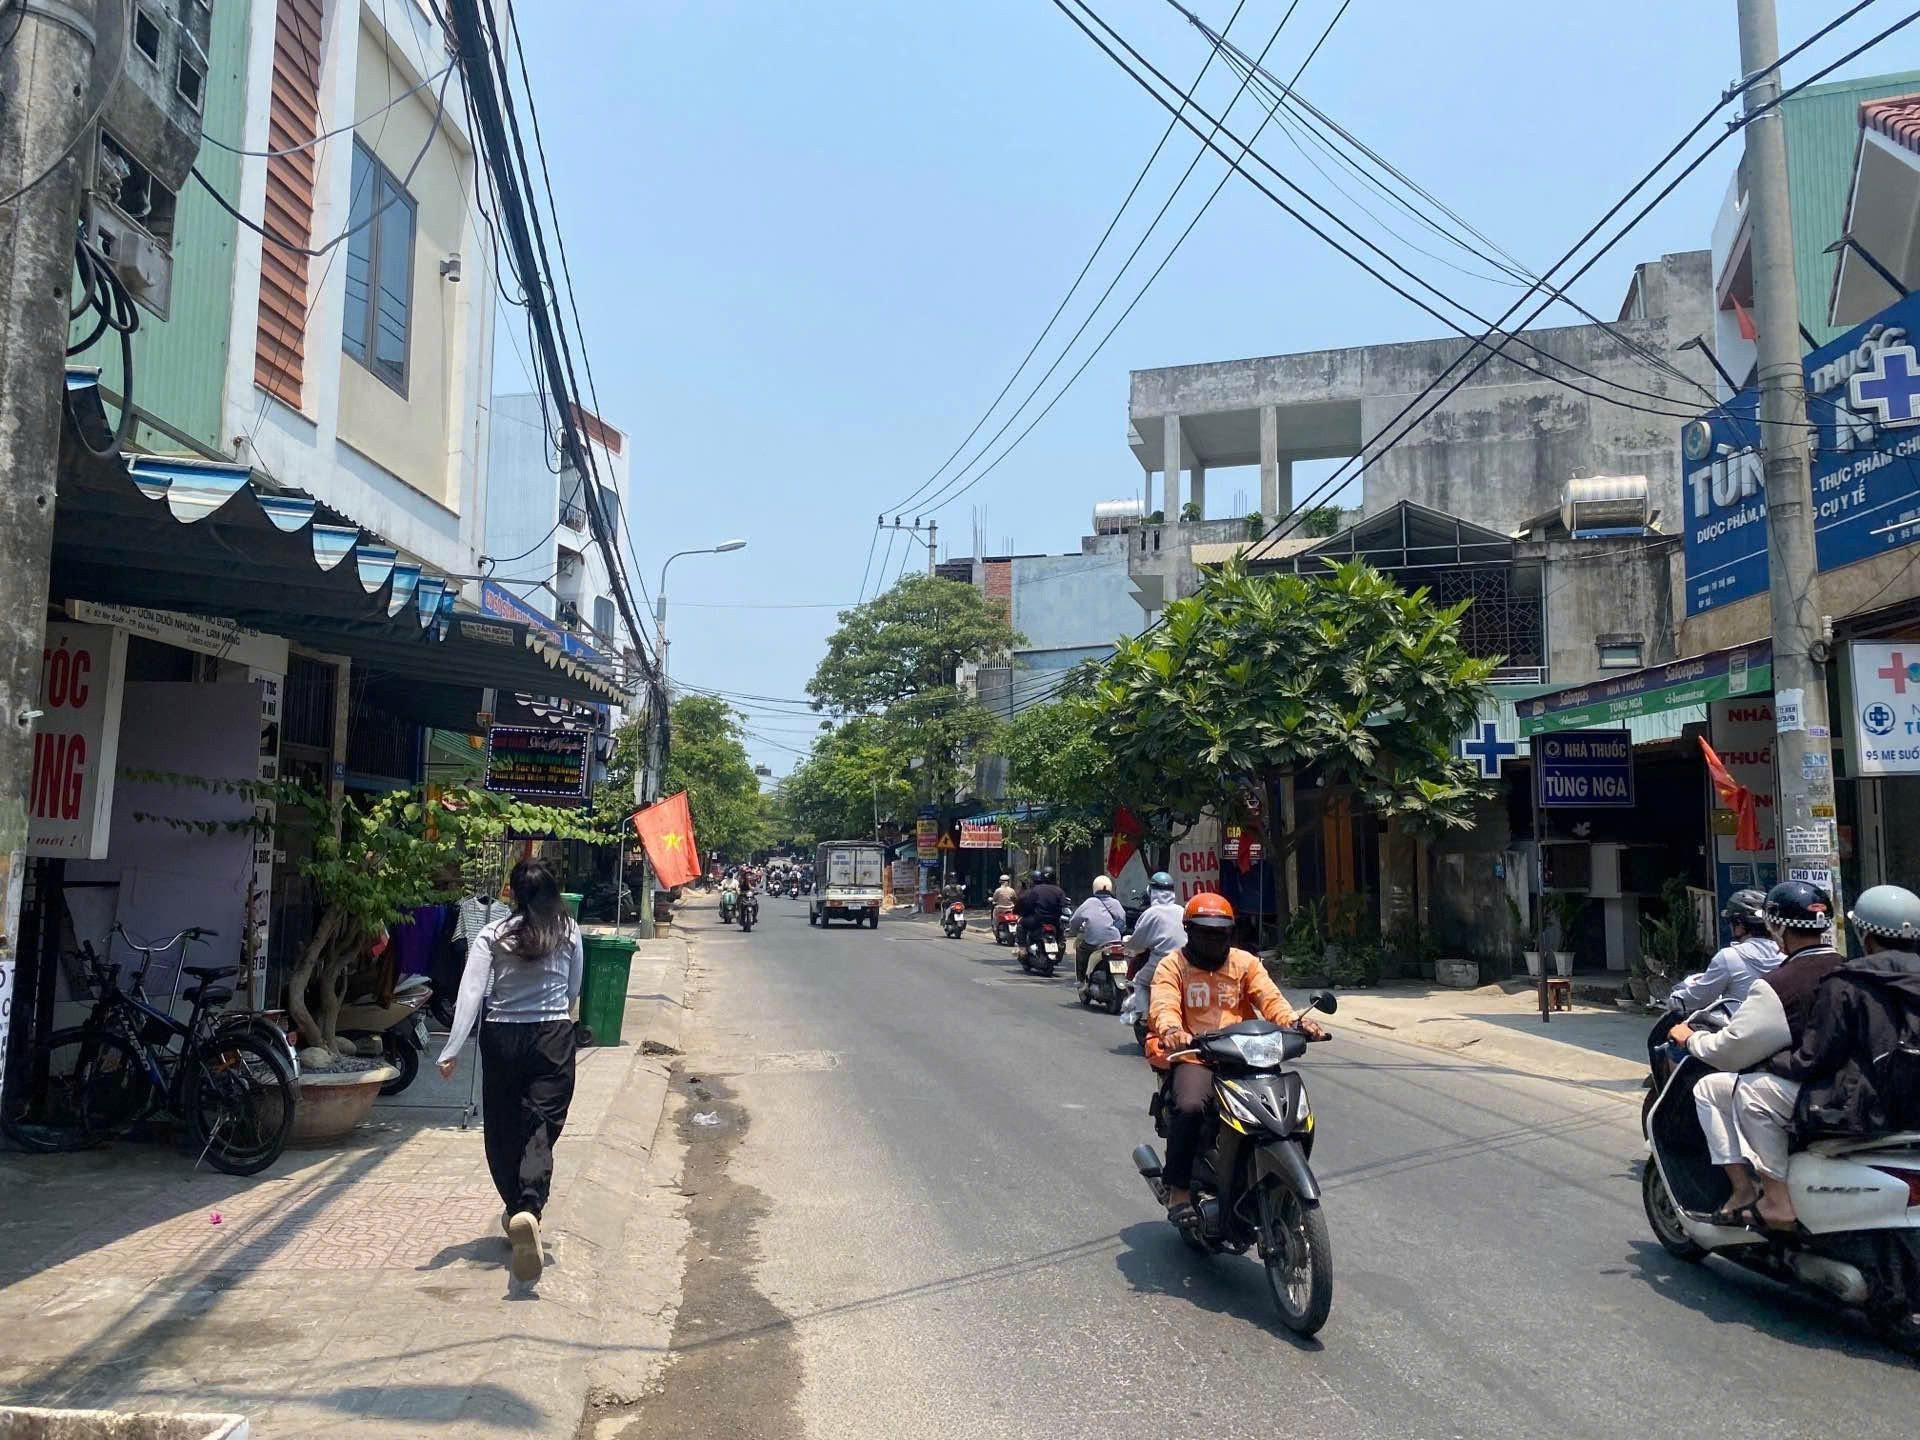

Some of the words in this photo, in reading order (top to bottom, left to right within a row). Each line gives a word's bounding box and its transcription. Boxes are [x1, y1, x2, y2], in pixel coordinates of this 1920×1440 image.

[1819, 467, 1852, 491] THỰC
[1820, 498, 1840, 518] CỤ
[1839, 495, 1851, 510] Y
[1851, 479, 1867, 504] TẾ
[1697, 520, 1726, 545] DƯỢC
[44, 637, 91, 709] ÓC
[1665, 661, 1705, 682] Salonpas
[1728, 704, 1774, 722] NHÀ
[1564, 741, 1588, 759] NHÀ
[1590, 737, 1627, 759] THUỐC
[1866, 750, 1879, 761] 95
[1881, 749, 1896, 763] MẸ
[1546, 770, 1589, 798] TÙNG
[1592, 776, 1628, 798] NGA
[1179, 847, 1220, 873] CHÁ
[1791, 869, 1809, 881] CHO
[1810, 869, 1829, 881] VAY
